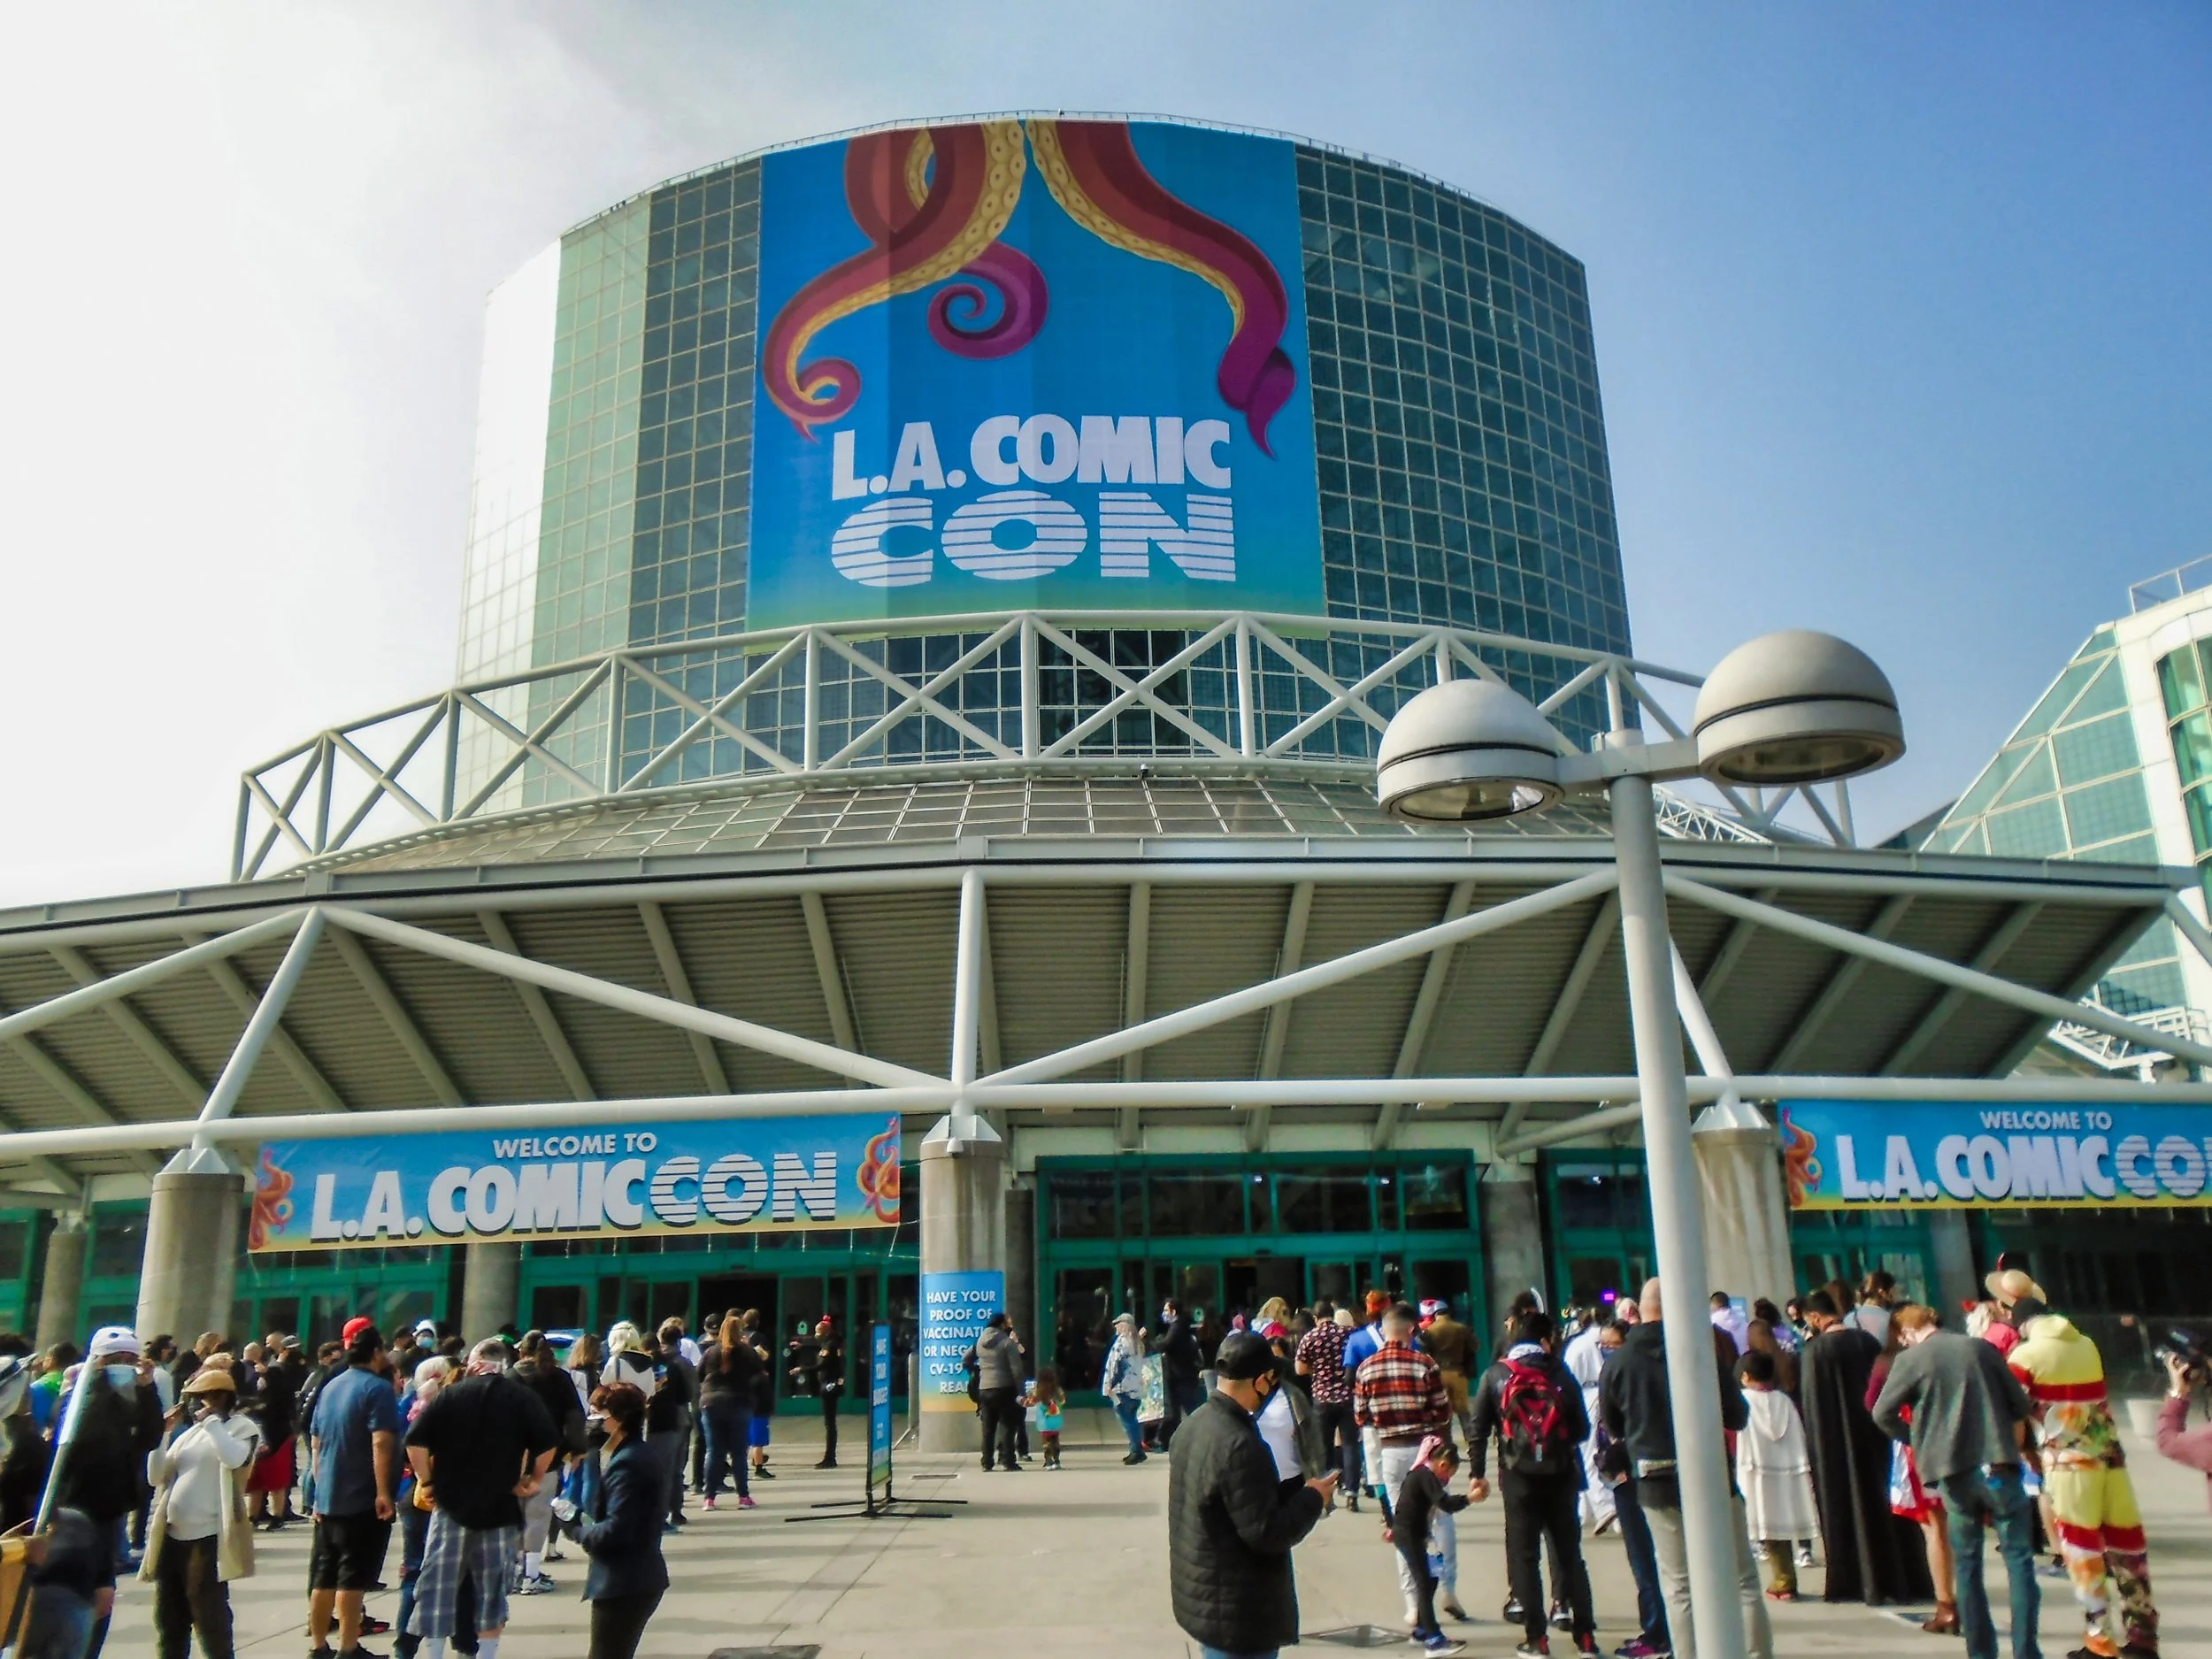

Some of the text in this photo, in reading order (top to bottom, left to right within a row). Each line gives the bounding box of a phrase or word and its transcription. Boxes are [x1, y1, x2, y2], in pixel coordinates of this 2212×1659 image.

[832, 413, 1232, 501] L.A. COMIC
[831, 490, 1236, 587] CON
[1980, 1111, 2112, 1130] WELCOME TO
[493, 1132, 657, 1158] WELCOME TO
[1836, 1135, 2212, 1201] L.A. COMIC CO
[311, 1152, 836, 1240] L.A. COMIC CON
[926, 1290, 996, 1303] HAVE YOUR
[930, 1309, 992, 1321] PROOF OF
[924, 1345, 937, 1357] OR
[930, 1363, 963, 1375] CV-19
